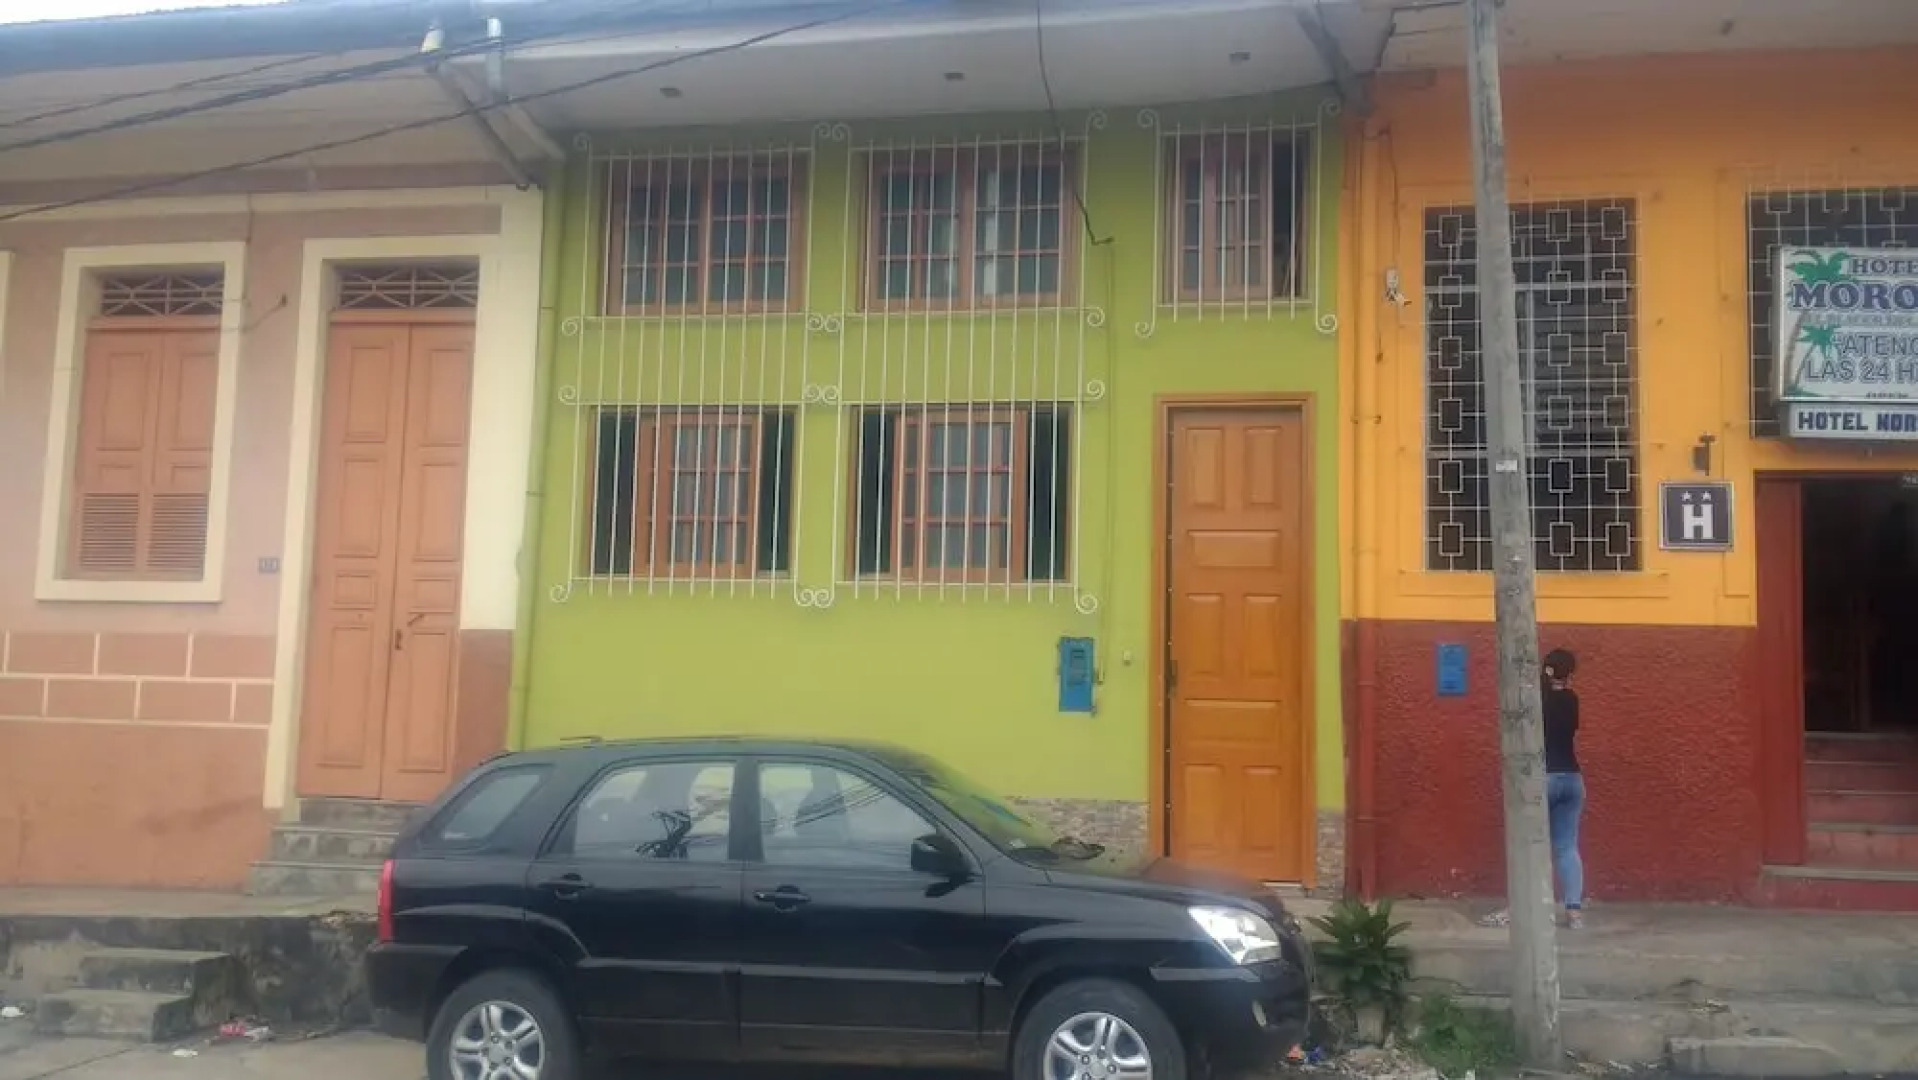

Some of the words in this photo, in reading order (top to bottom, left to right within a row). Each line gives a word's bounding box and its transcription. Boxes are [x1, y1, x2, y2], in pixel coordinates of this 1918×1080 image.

[1792, 283, 1918, 310] MORO
[1807, 360, 1854, 381] LAS
[1861, 360, 1890, 381] 24
[1898, 361, 1918, 382] H
[1798, 411, 1868, 431] HOTEL
[1682, 504, 1714, 540] H
